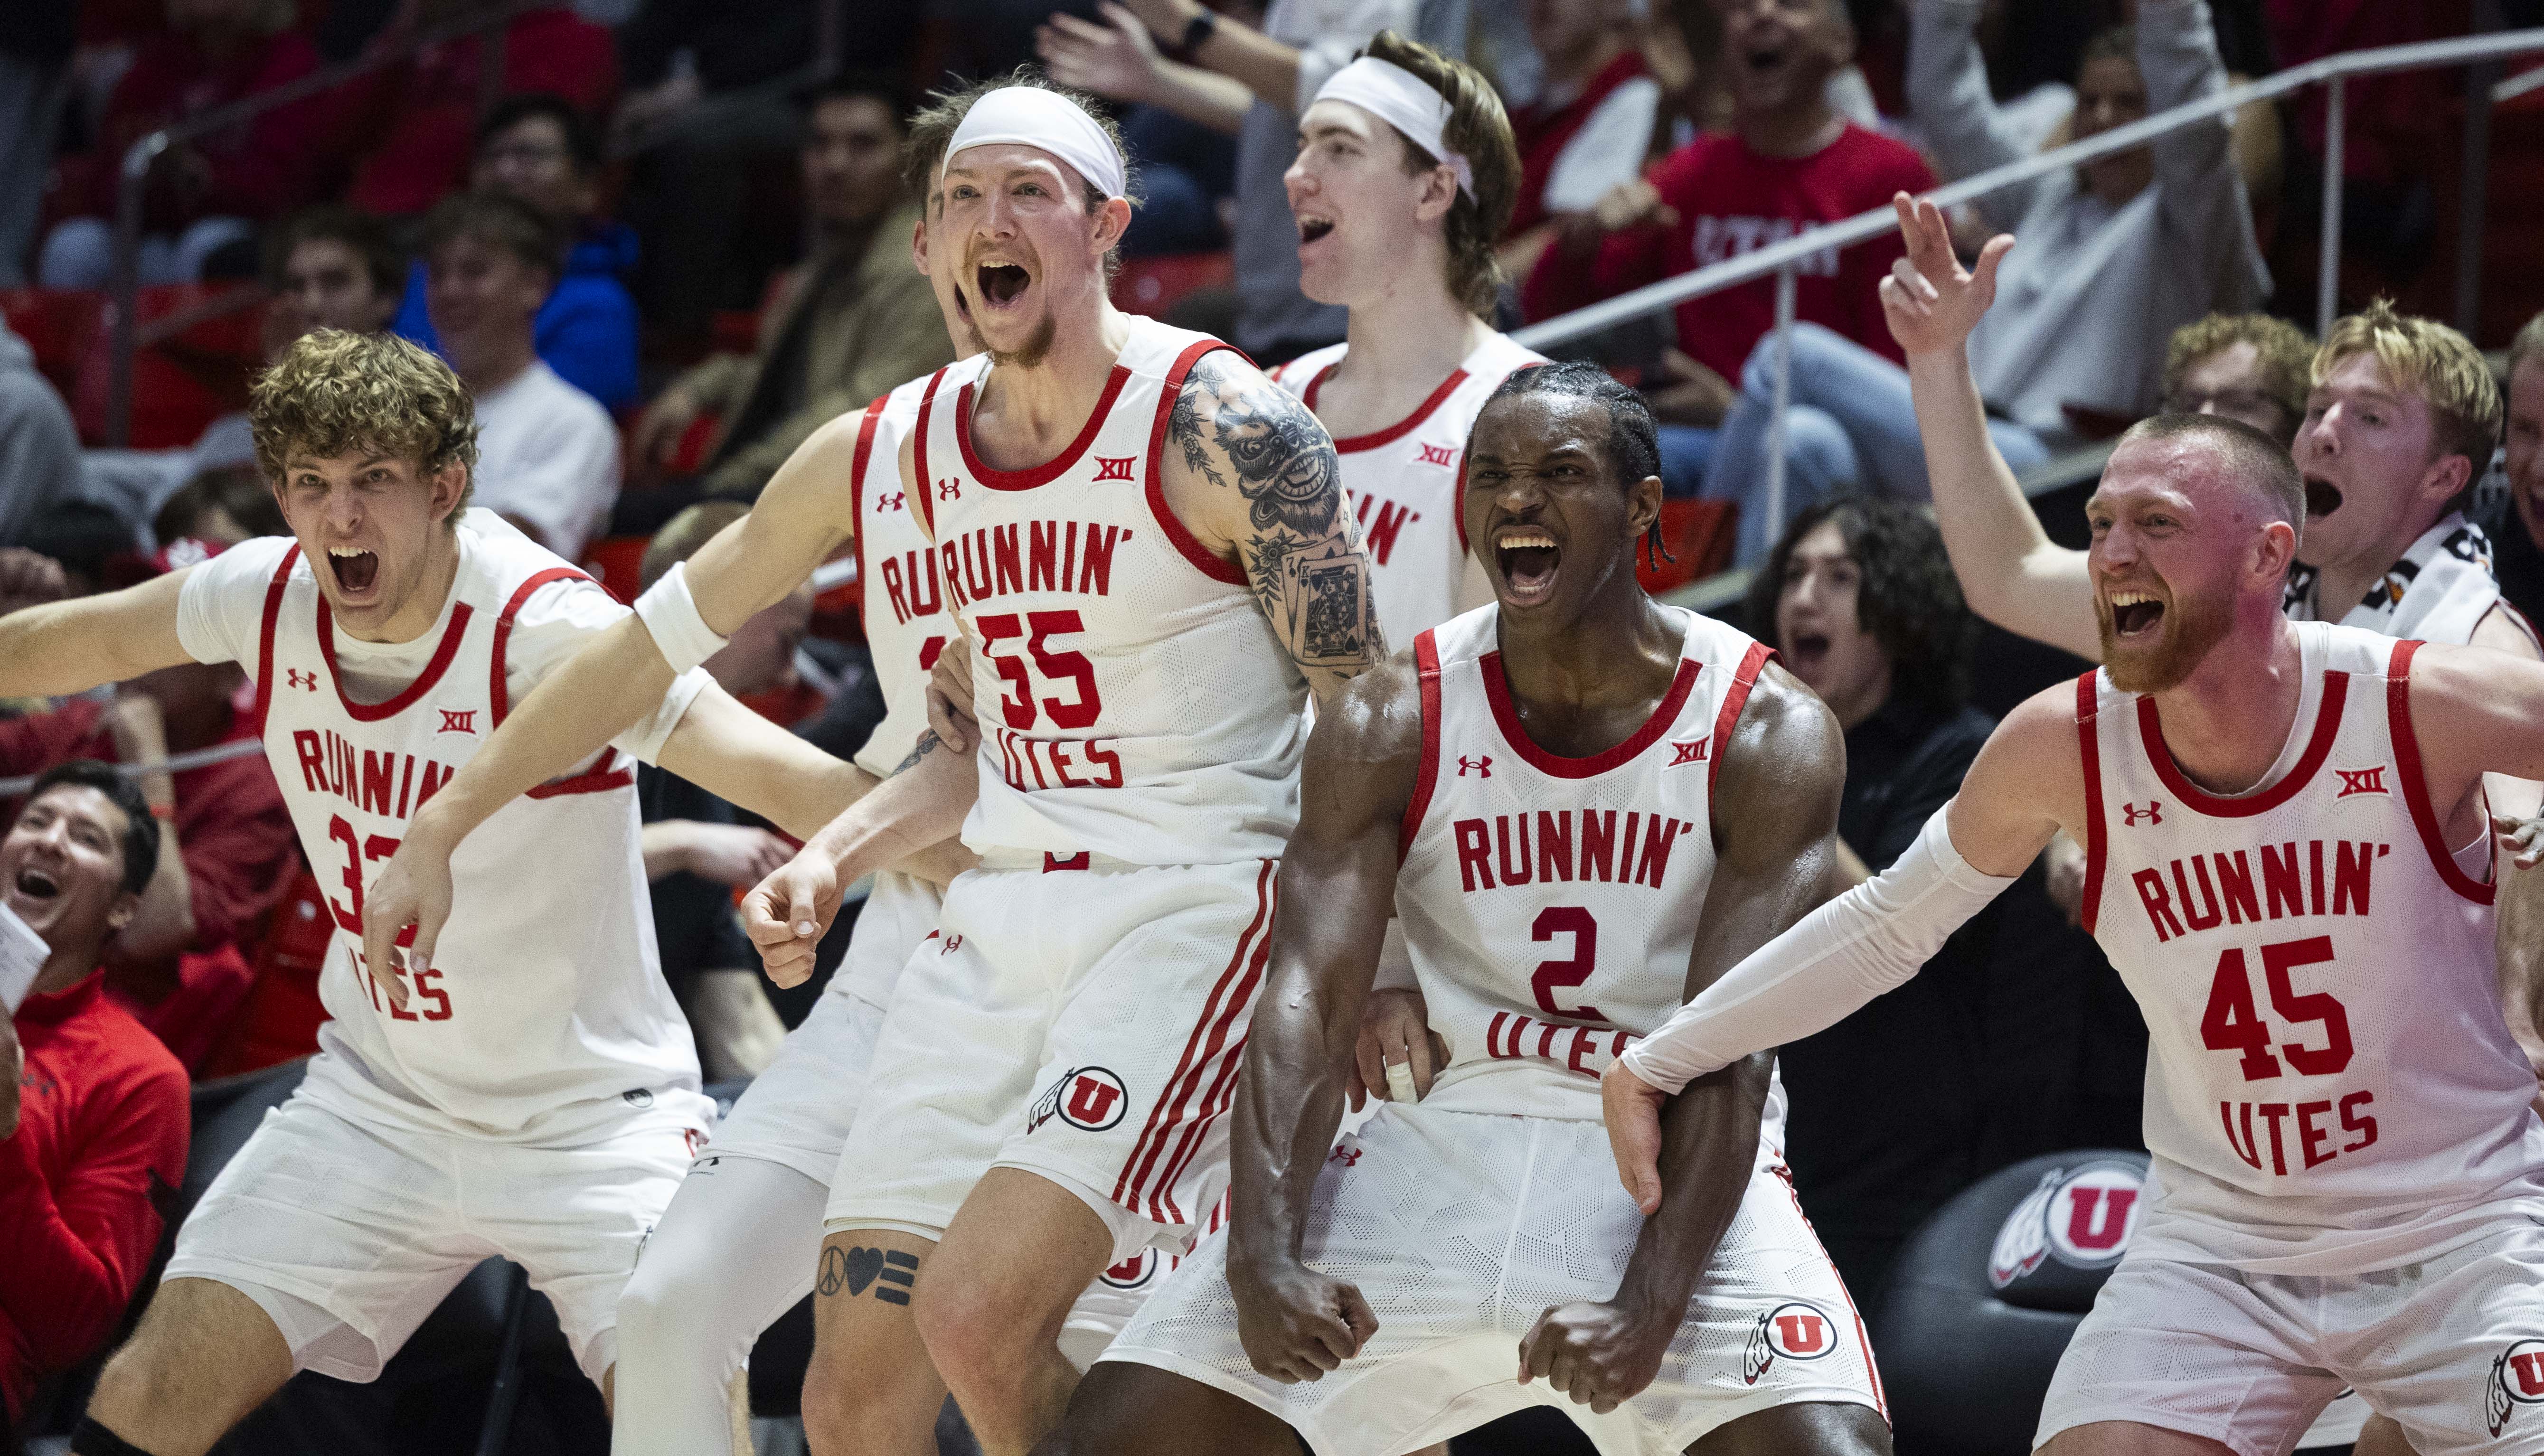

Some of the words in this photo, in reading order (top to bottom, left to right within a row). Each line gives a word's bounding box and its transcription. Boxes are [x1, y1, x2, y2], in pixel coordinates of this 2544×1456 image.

[1092, 455, 1137, 482] XII
[942, 520, 1133, 611] RUNNIN'
[976, 610, 1102, 731] 55
[437, 709, 478, 735] XII
[1670, 736, 1711, 767] XII
[2335, 765, 2389, 798] XII
[1453, 808, 1694, 892] RUNNIN'
[2131, 839, 2390, 942] RUNNIN'
[1531, 906, 1611, 1023] 2
[2199, 934, 2355, 1082] 45
[1067, 1075, 1121, 1125] U
[2220, 1090, 2378, 1176] UTES
[2068, 1186, 2139, 1249] U
[1775, 1313, 1824, 1354] U
